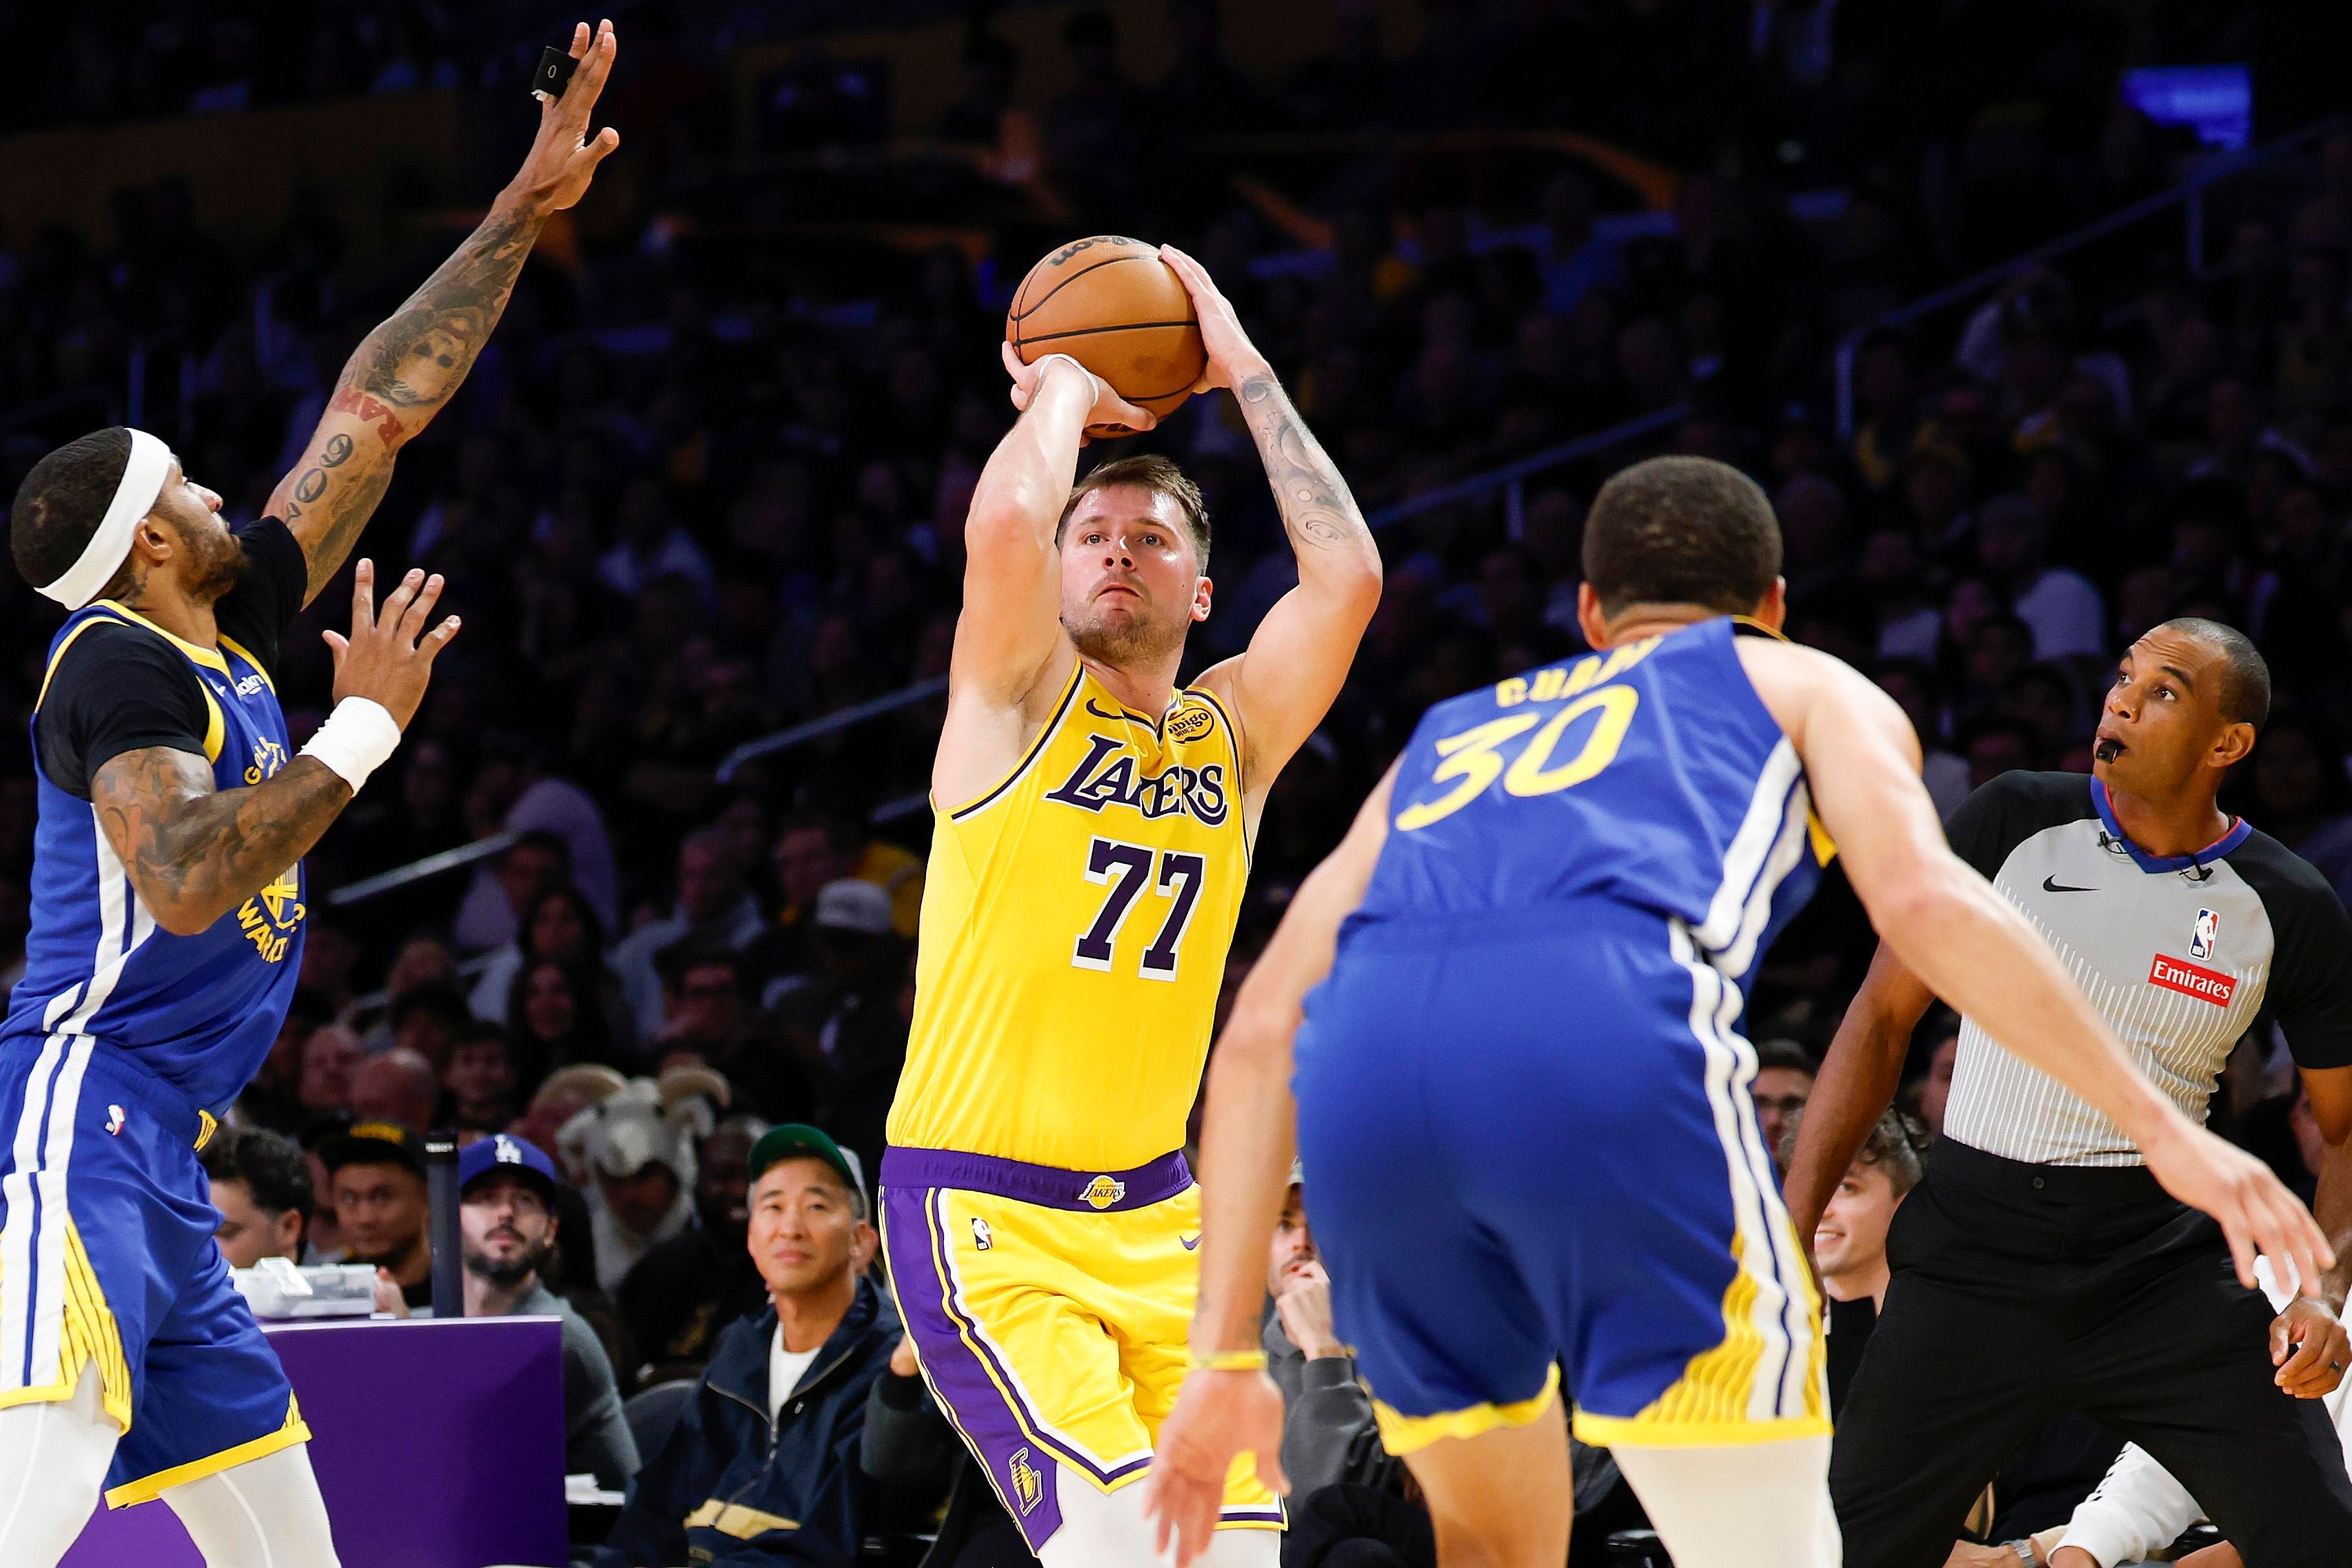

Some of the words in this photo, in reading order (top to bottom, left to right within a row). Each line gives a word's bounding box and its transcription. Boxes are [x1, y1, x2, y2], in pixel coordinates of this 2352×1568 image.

[1394, 683, 1640, 832] 30
[1070, 834, 1207, 983] 77
[2153, 960, 2231, 1000] Emirates
[1080, 1184, 1123, 1201] LAKERS
